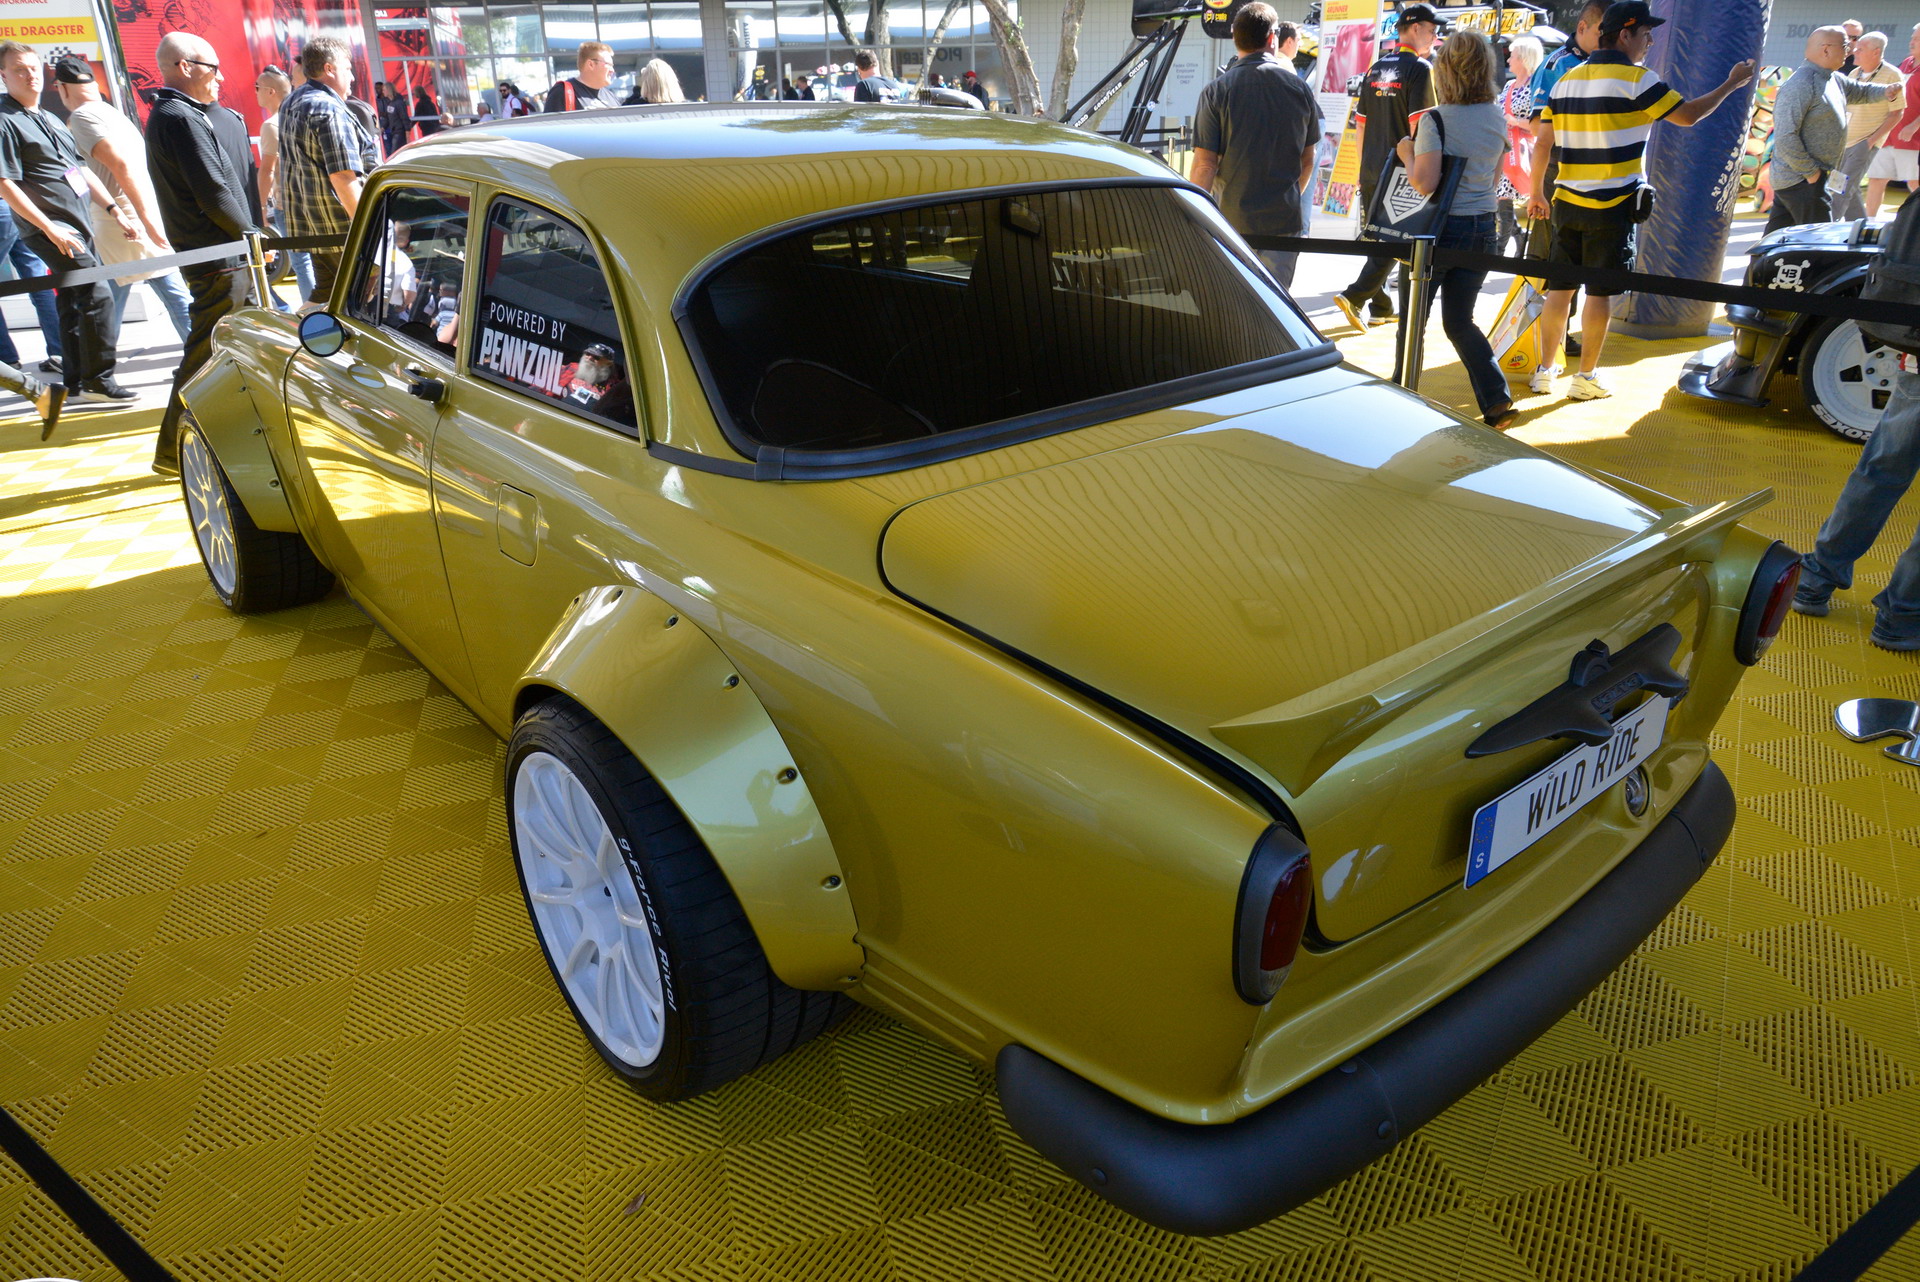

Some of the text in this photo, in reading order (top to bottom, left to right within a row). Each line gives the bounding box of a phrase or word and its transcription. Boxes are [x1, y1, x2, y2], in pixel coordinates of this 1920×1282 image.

[20, 24, 85, 36] DRAGSTER
[1781, 268, 1798, 279] 43
[490, 301, 567, 343] POWERED BY
[479, 327, 564, 396] PENNZOIL
[1527, 717, 1645, 836] WILD RIDE
[1475, 852, 1485, 869] S
[658, 946, 677, 1012] Rival
